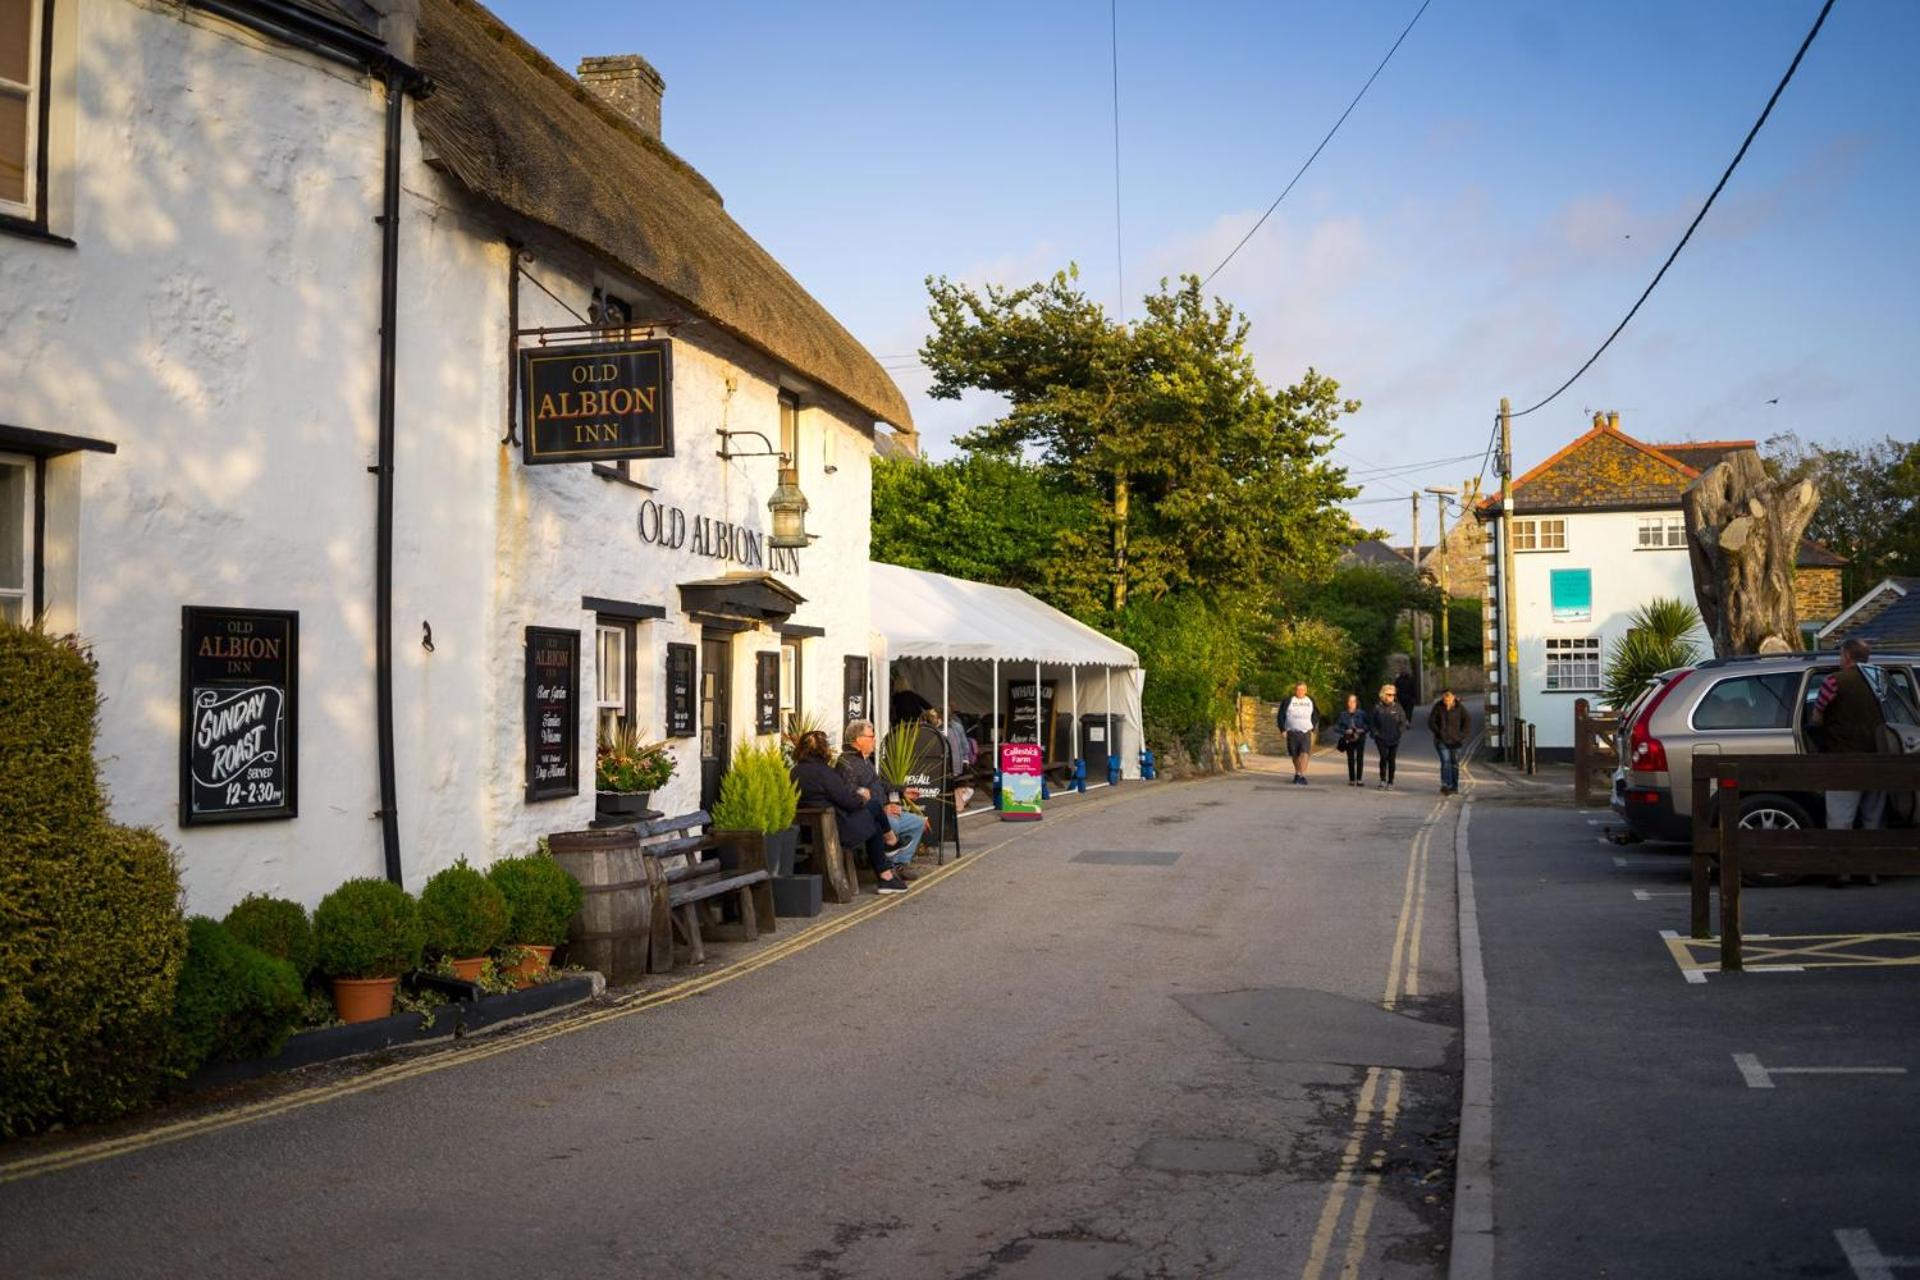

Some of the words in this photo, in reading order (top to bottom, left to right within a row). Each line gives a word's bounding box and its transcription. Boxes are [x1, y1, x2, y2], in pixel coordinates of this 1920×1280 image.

[572, 364, 618, 384] OLD
[538, 386, 656, 419] ALBION
[575, 423, 619, 443] INN
[639, 499, 685, 549] OLD
[690, 514, 763, 567] ALBION
[768, 546, 800, 576] INN
[227, 621, 253, 633] OLD
[199, 635, 279, 659] ALBION
[227, 661, 252, 673] INN
[198, 692, 266, 749] SUNDAY
[212, 724, 266, 779] ROAST
[247, 767, 274, 780] SERVED
